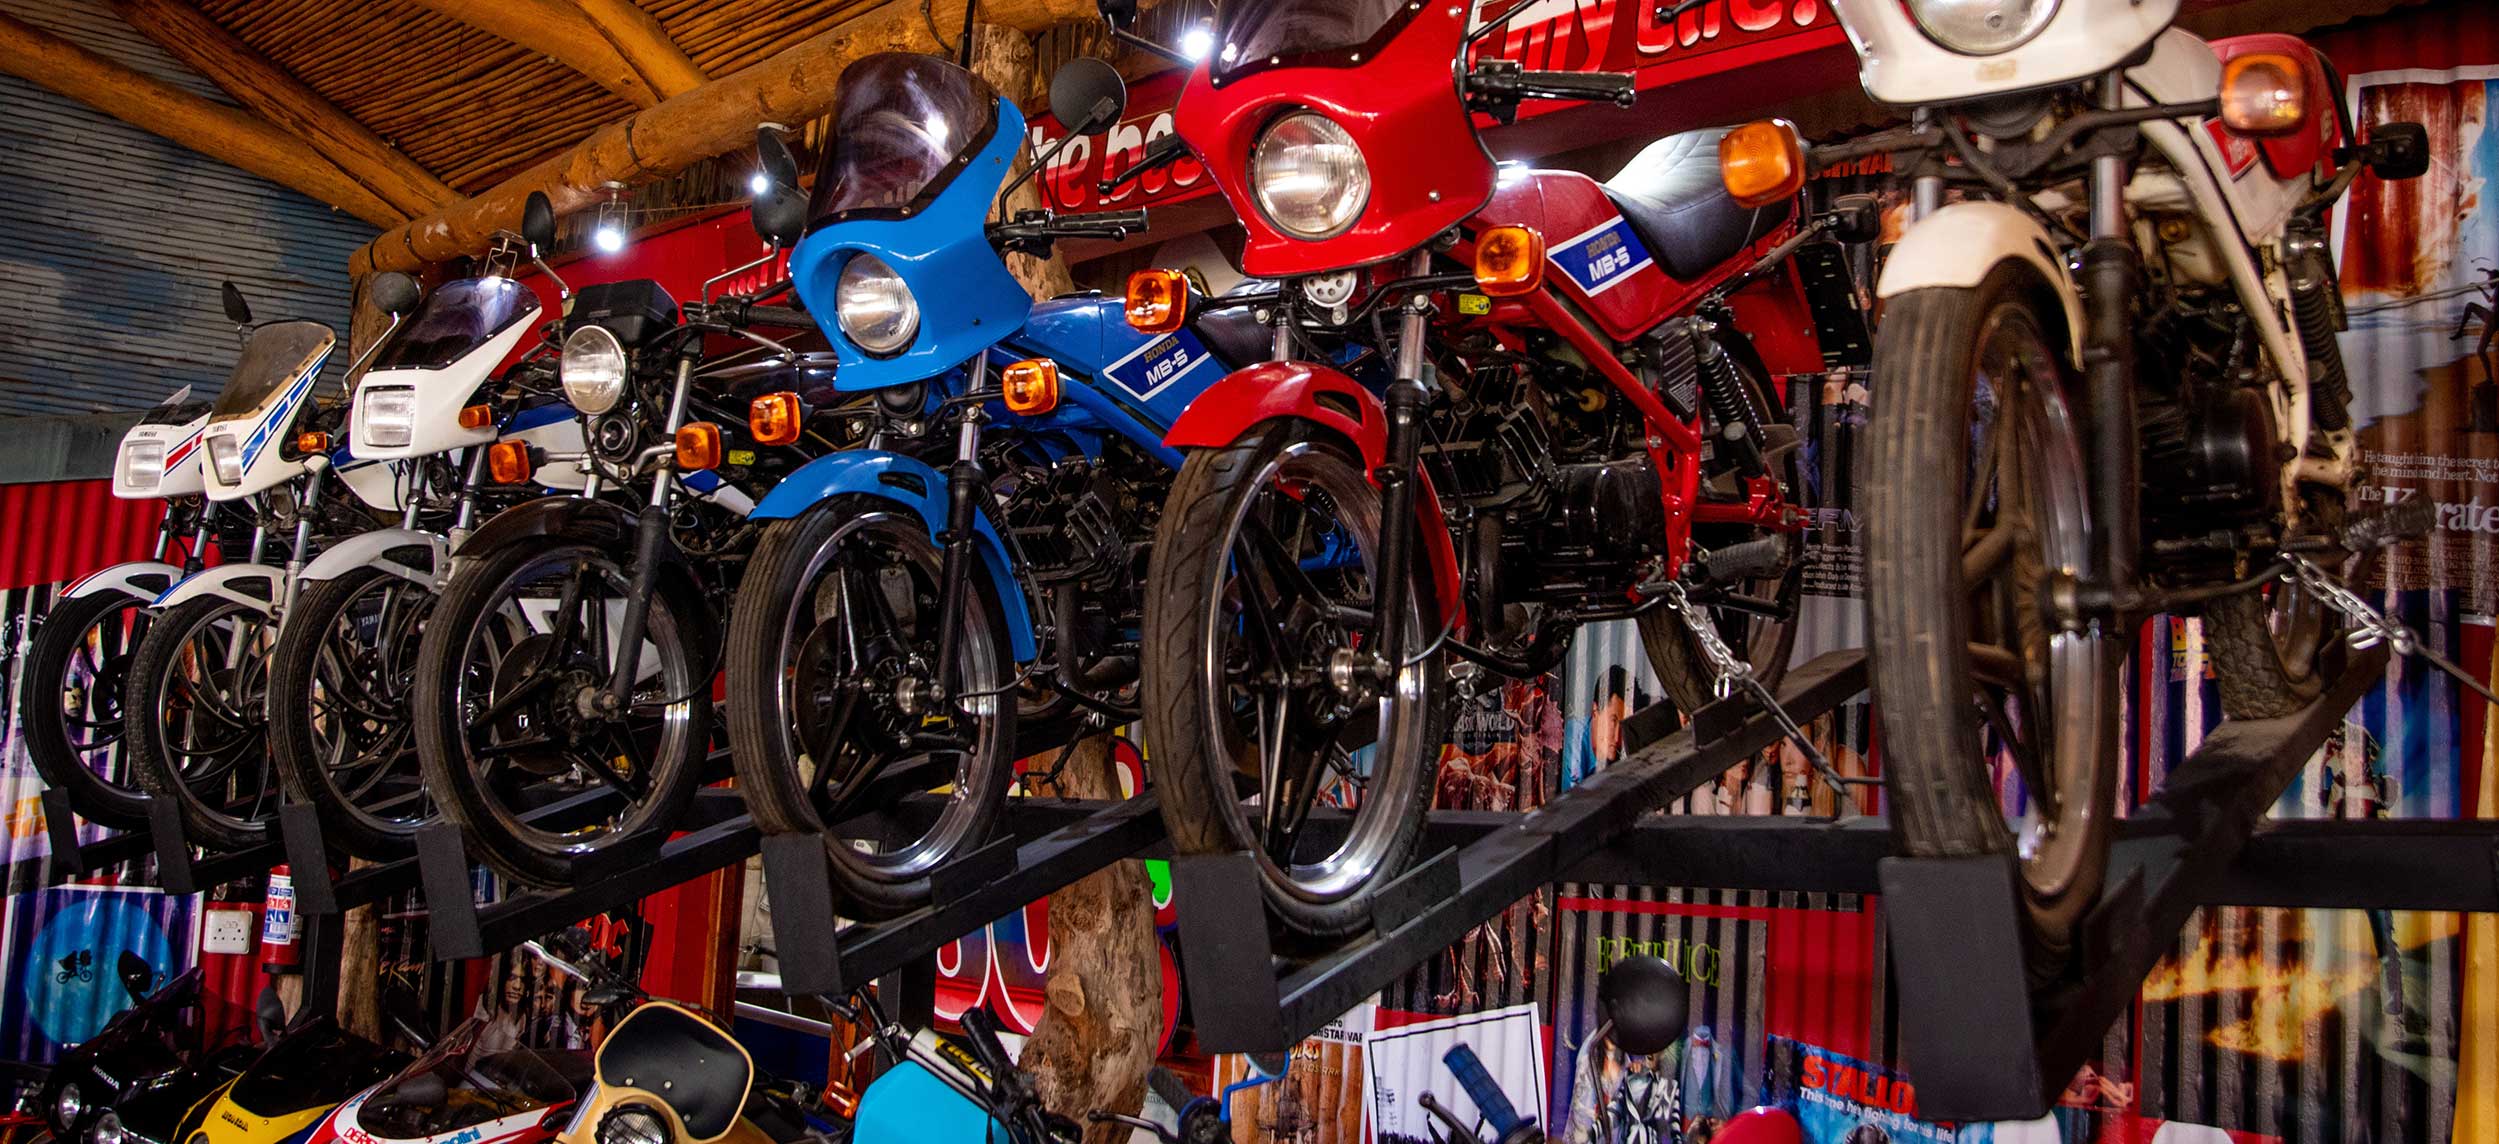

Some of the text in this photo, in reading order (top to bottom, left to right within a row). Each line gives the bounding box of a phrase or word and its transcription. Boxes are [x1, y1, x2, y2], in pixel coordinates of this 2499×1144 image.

[1587, 245, 1631, 282] MB-5
[1143, 335, 1179, 363] HONDA
[1145, 347, 1189, 386] MB-5
[2359, 485, 2381, 501] The
[92, 1064, 120, 1091] HONDA
[1801, 1055, 1919, 1119] STALLO
[221, 1109, 249, 1132] HONDA
[1800, 1086, 1824, 1104] This
[1903, 1118, 1919, 1133] for
[1935, 1128, 1955, 1143] life
